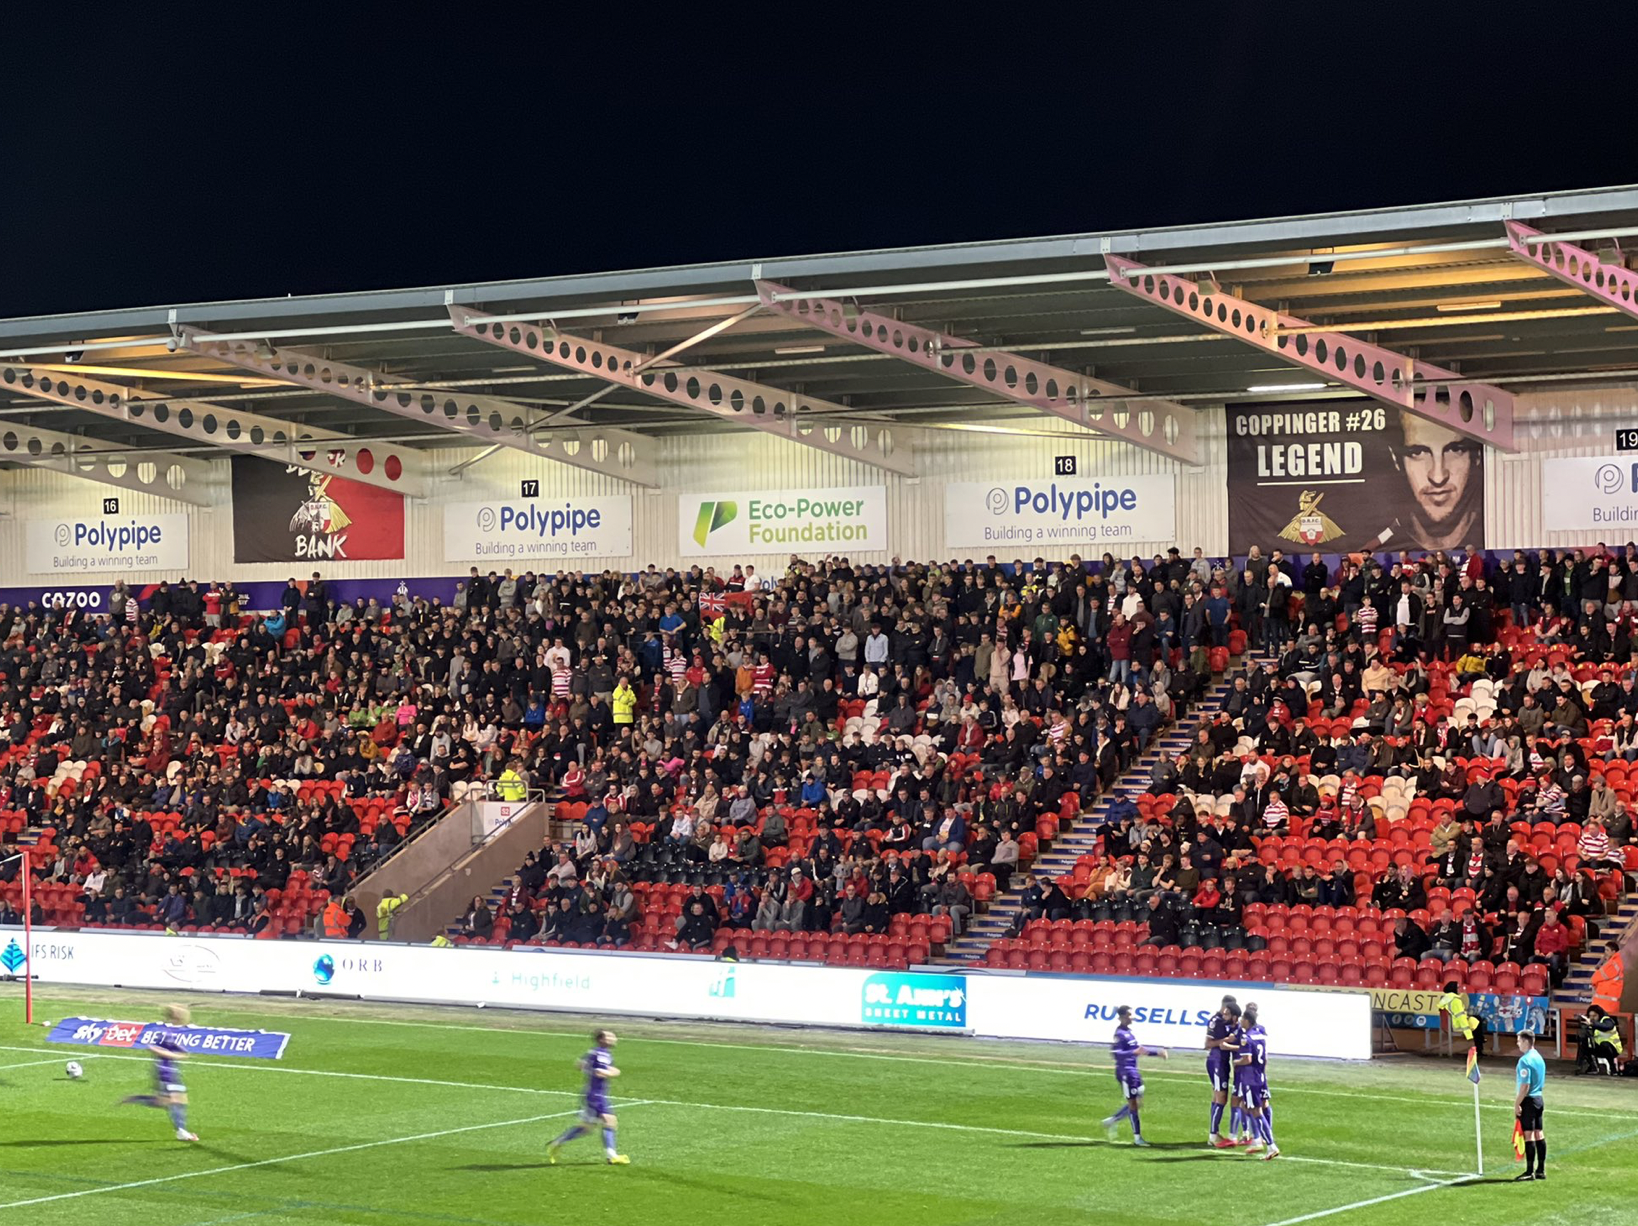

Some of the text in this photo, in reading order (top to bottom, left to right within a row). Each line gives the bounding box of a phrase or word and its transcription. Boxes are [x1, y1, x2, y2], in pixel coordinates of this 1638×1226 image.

[1236, 408, 1386, 436] COPPINGER #26
[1620, 432, 1638, 447] 19
[1058, 458, 1073, 472] 18
[1258, 442, 1362, 477] LEGEND
[523, 482, 536, 495] 17
[105, 500, 116, 512] 16
[750, 498, 864, 520] Eco-Power
[1015, 482, 1136, 520] Polypipe
[500, 502, 600, 537] Polypipe
[75, 520, 161, 551] Polypipe
[750, 521, 868, 543] Foundation
[984, 524, 1132, 542] Building a winning team
[294, 534, 348, 558] BANK
[476, 541, 596, 557] Building a winning team
[54, 555, 158, 570] Building a winning team
[42, 592, 100, 608] CAZOO
[31, 944, 74, 960] IFS RISK
[512, 972, 590, 991] Highfield
[1372, 993, 1444, 1012] NCAST
[865, 1008, 961, 1022] SHEET METAL
[1084, 1003, 1210, 1026] RUSELLS
[72, 1022, 103, 1044] sky
[104, 1025, 138, 1042] bet
[202, 1034, 256, 1052] BETTER
[1256, 1044, 1264, 1064] 2
